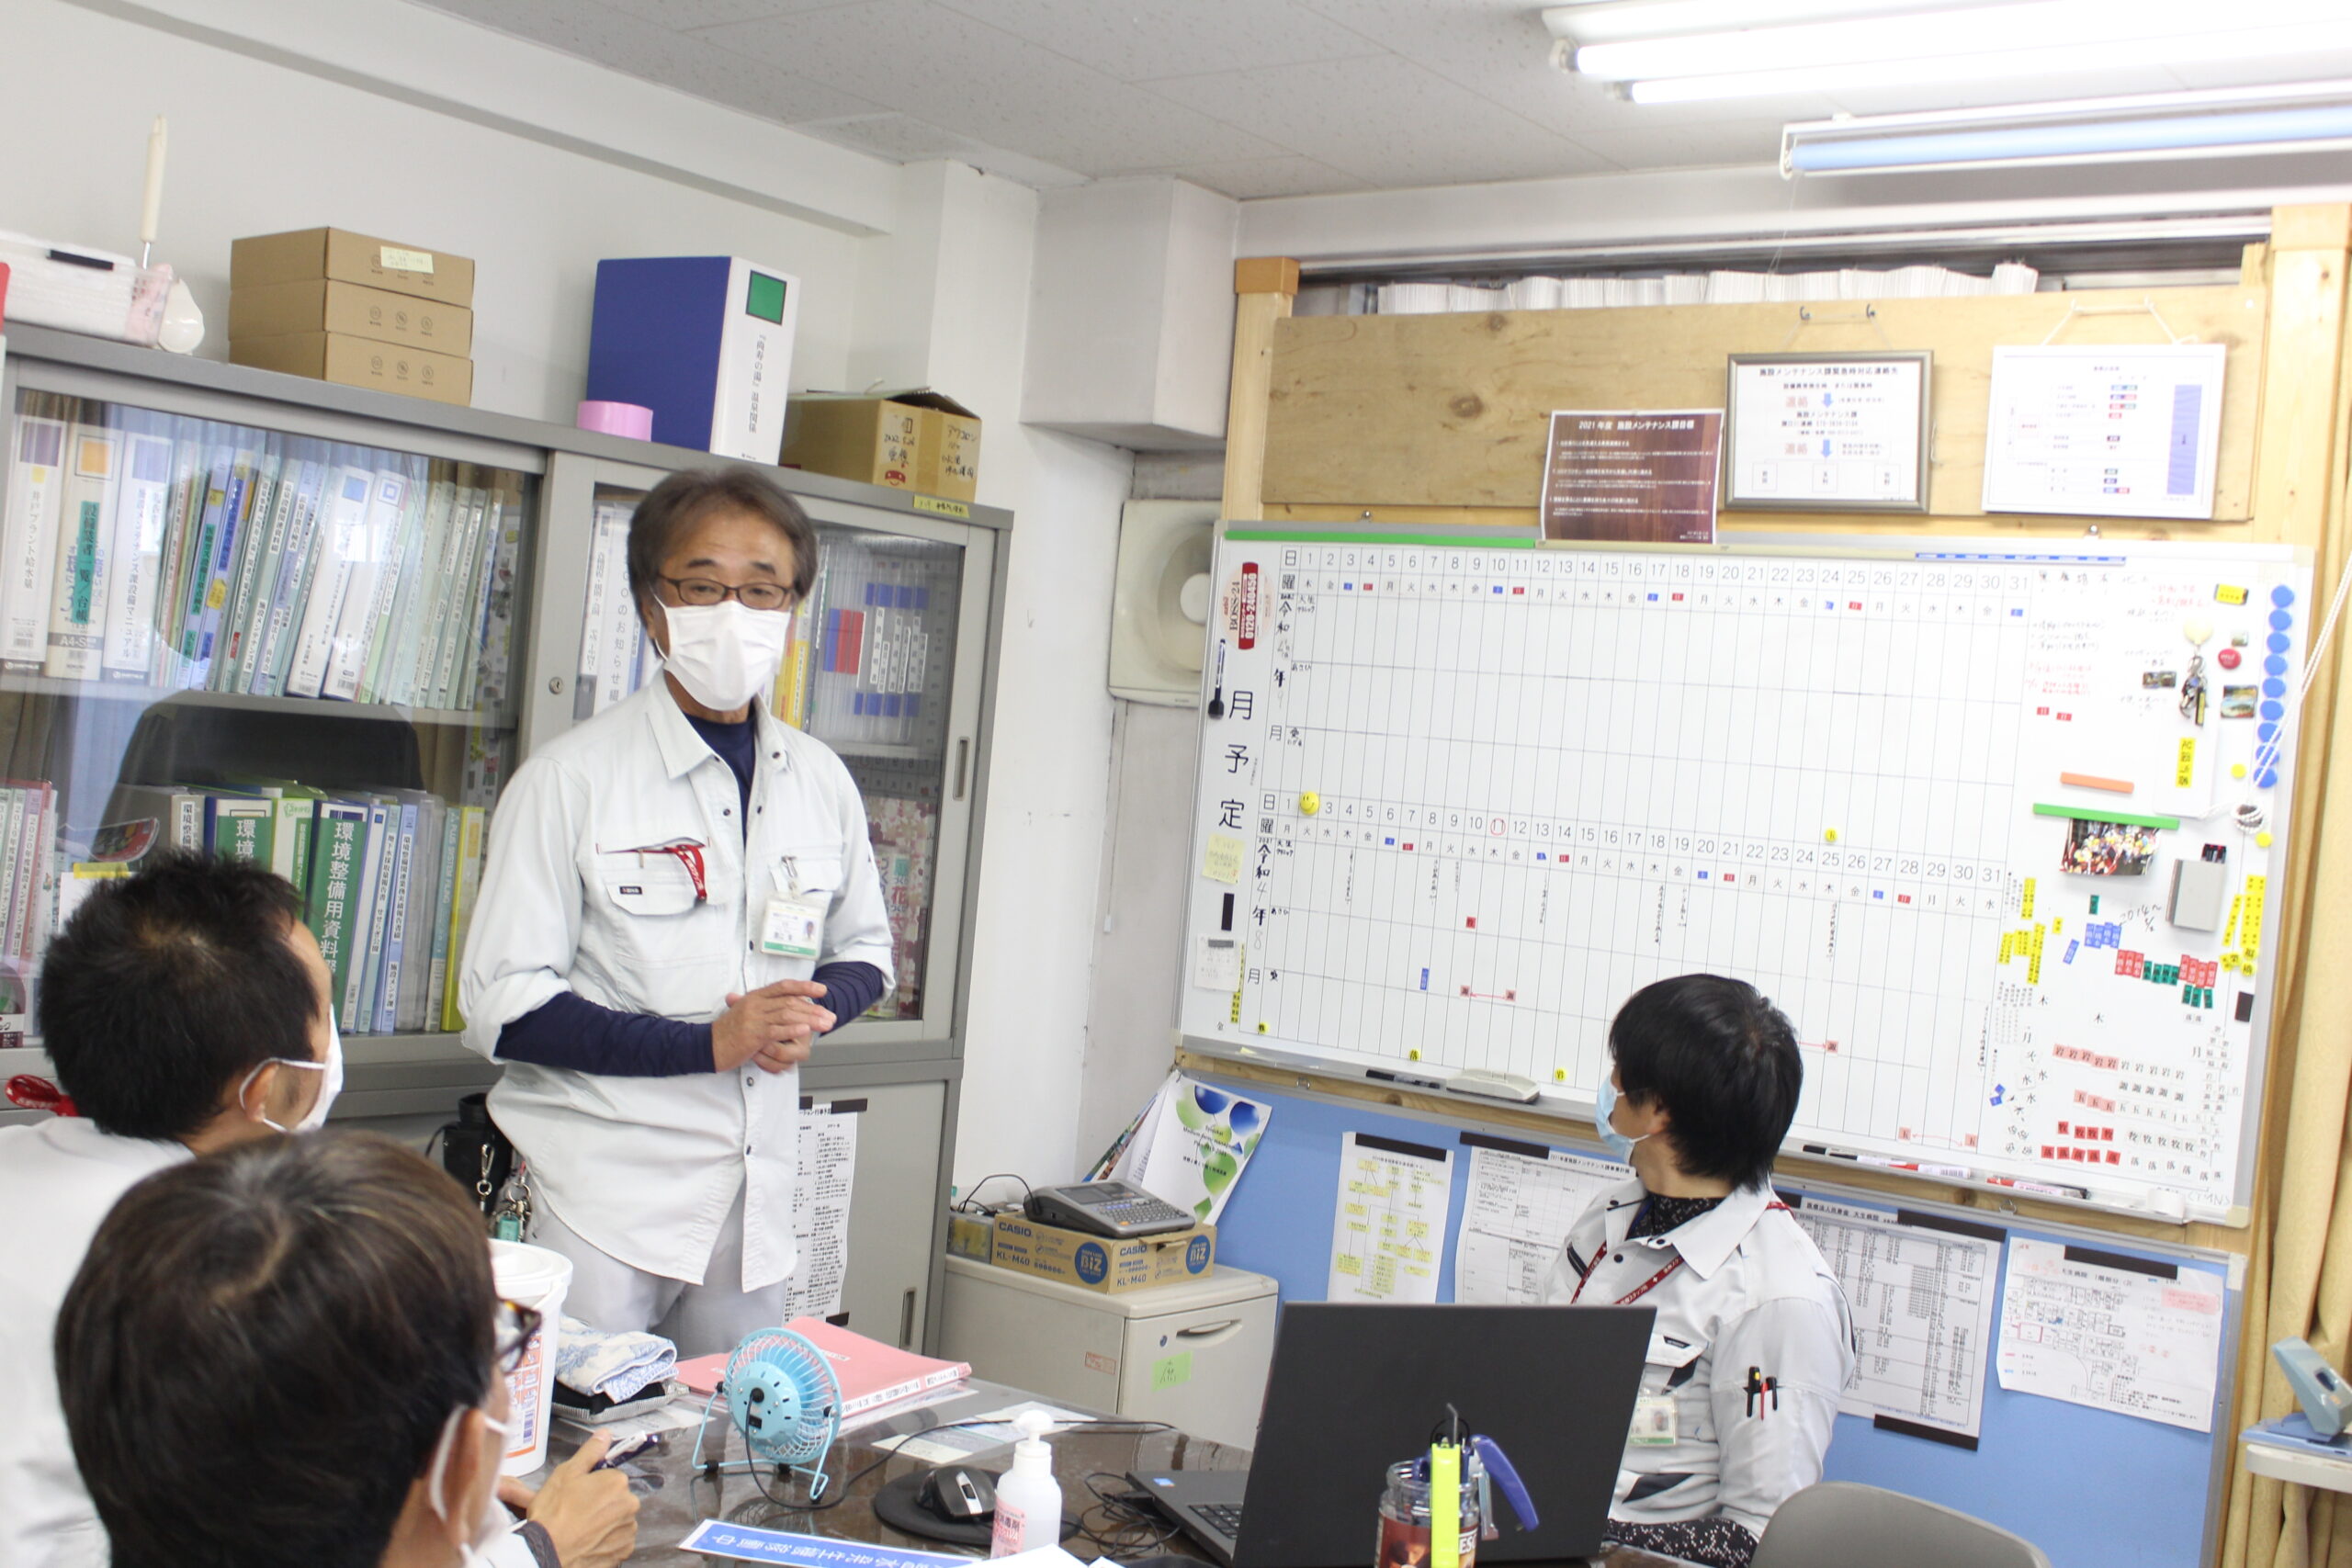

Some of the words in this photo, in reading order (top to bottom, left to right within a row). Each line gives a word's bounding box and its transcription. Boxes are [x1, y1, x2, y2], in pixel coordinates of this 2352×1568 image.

[1284, 550, 1297, 566] 日
[1326, 552, 1335, 567] 2
[1346, 553, 1355, 567] 3
[1367, 554, 1374, 567] 4
[1387, 554, 1396, 568] 5
[1408, 555, 1417, 569] 6
[1430, 555, 1438, 569] 7
[1451, 557, 1460, 570] 8
[1473, 557, 1481, 571] 9
[1493, 558, 1506, 572] 10
[1516, 558, 1528, 572] 11
[1536, 559, 1551, 573] 12
[1559, 560, 1573, 574] 13
[1582, 561, 1595, 574] 14
[1605, 561, 1619, 576] 15
[1628, 562, 1643, 577] 16
[1652, 563, 1666, 577] 17
[1676, 564, 1690, 579] 18
[1700, 565, 1714, 580] 19
[1721, 565, 1740, 581] 20
[1747, 567, 1764, 581] 21
[1770, 568, 1790, 582] 22
[1795, 569, 1815, 583] 23
[1821, 570, 1839, 583] 24
[1847, 570, 1866, 585] 25
[1873, 571, 1893, 586] 26
[1899, 571, 1918, 587] 27
[1926, 572, 1946, 589] 28
[1953, 573, 1973, 589] 29
[1980, 575, 2001, 590] 30
[2008, 575, 2028, 591] 31
[1282, 573, 1295, 590] 曜
[1228, 581, 1239, 630] BOSS-24
[1244, 572, 1258, 639] 0120-240450
[1260, 818, 1274, 834] 曜
[1263, 794, 1276, 810] 日
[1325, 801, 1333, 815] 3
[1345, 804, 1352, 817] 4
[1365, 805, 1374, 819] 5
[1386, 807, 1395, 821] 6
[1408, 808, 1416, 823] 7
[1428, 811, 1437, 826] 8
[1450, 814, 1458, 828] 9
[1469, 816, 1483, 830] 10
[1492, 820, 1504, 833] 11
[1513, 820, 1527, 835] 12
[1535, 822, 1550, 838] 13
[1558, 825, 1571, 839] 14
[1581, 827, 1595, 841] 15
[1604, 829, 1618, 844] 16
[1627, 831, 1642, 846] 17
[1651, 834, 1666, 849] 18
[1675, 837, 1690, 852] 19
[1697, 839, 1715, 854] 20
[1722, 841, 1739, 856] 21
[1746, 843, 1764, 860] 22
[1770, 846, 1790, 862] 23
[1795, 849, 1814, 863] 24
[1821, 852, 1840, 867] 25
[1847, 853, 1866, 870] 26
[1873, 856, 1893, 872] 27
[1899, 859, 1919, 875] 28
[1927, 862, 1946, 878] 29
[1953, 864, 1973, 881] 30
[1982, 866, 2000, 883] 31
[999, 1222, 1033, 1238] CASIO
[1119, 1243, 1148, 1257] CASIO
[996, 1251, 1031, 1267] KL-M40
[1116, 1273, 1148, 1288] KL-M40
